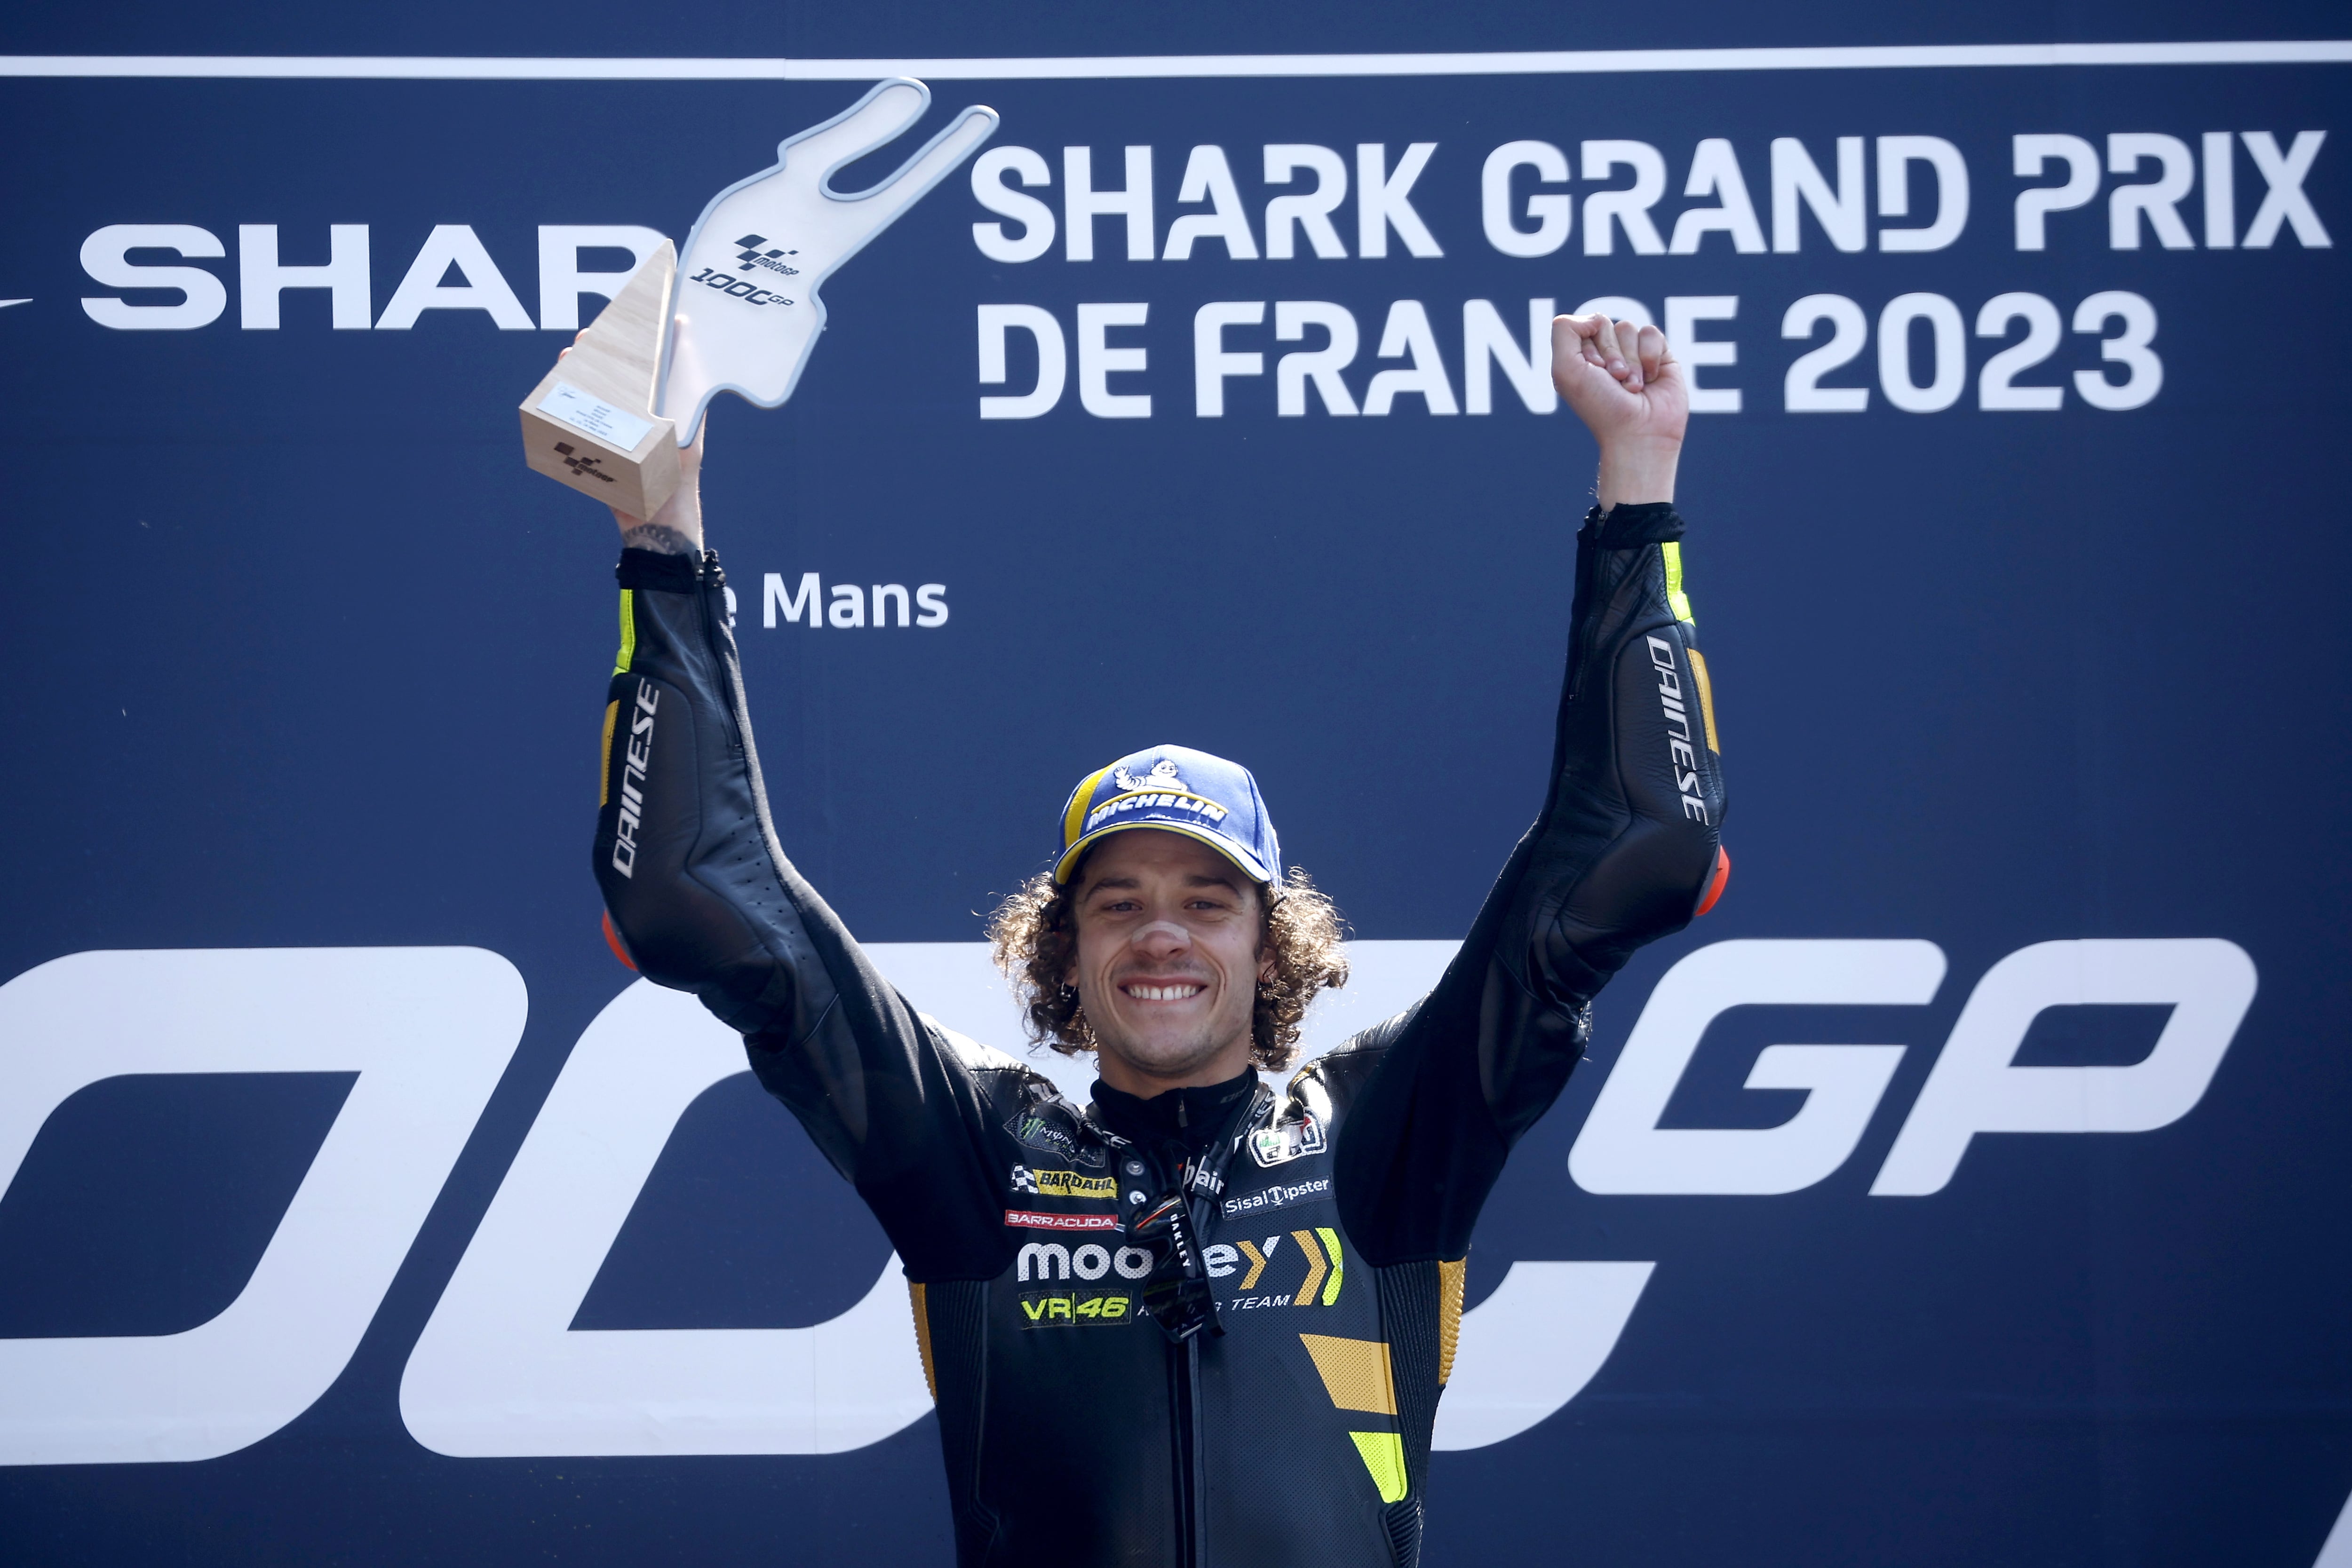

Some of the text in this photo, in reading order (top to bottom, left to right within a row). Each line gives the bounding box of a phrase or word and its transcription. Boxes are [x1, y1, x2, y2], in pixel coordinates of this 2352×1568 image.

[971, 130, 2333, 263] SHARK GRAND PRIX
[80, 224, 677, 331] SHAR
[977, 290, 2163, 420] DE FRANE 2023
[763, 572, 949, 629] Mans
[1646, 635, 1709, 826] DAINESE
[612, 677, 660, 879] DAINESE
[1086, 794, 1224, 832] MICHELIN
[1039, 1172, 1115, 1195] BARDAHL
[1008, 1213, 1114, 1227] BARRACUDA
[1170, 1213, 1191, 1267] OAKLEY
[1017, 1235, 1281, 1291] mooey
[1232, 1294, 1291, 1311] TEAM
